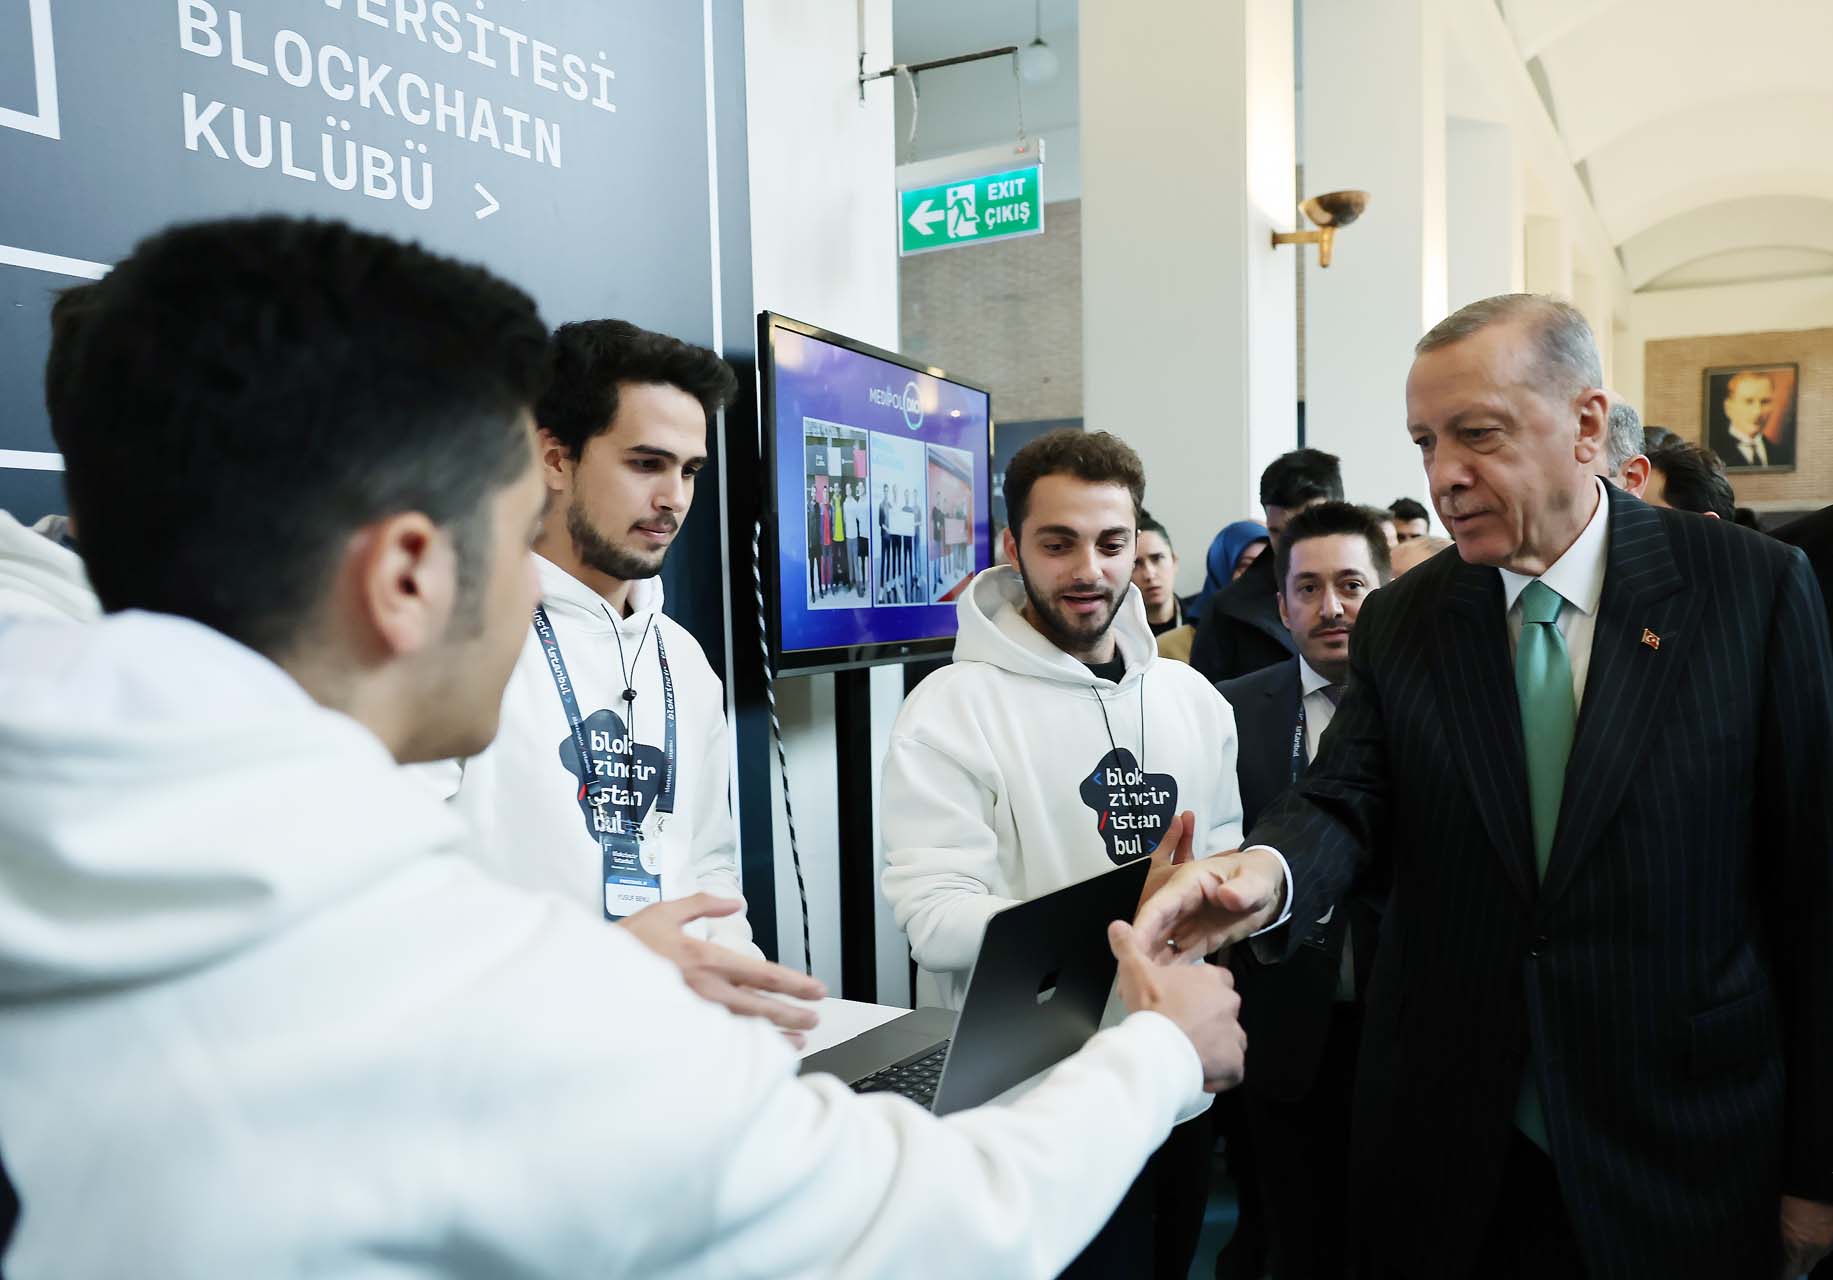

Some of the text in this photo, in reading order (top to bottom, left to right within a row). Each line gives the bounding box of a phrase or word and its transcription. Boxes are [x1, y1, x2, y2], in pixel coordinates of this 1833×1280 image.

[324, 0, 617, 113] ERSİTESİ
[178, 0, 562, 169] BLOCKCHAIN
[182, 92, 434, 210] KULÜBÜ
[987, 177, 1026, 201] EXIT
[984, 201, 1031, 230] ÇIKIŞ
[590, 729, 633, 756] blok
[592, 755, 657, 781] zincir
[1108, 786, 1171, 807] zincir
